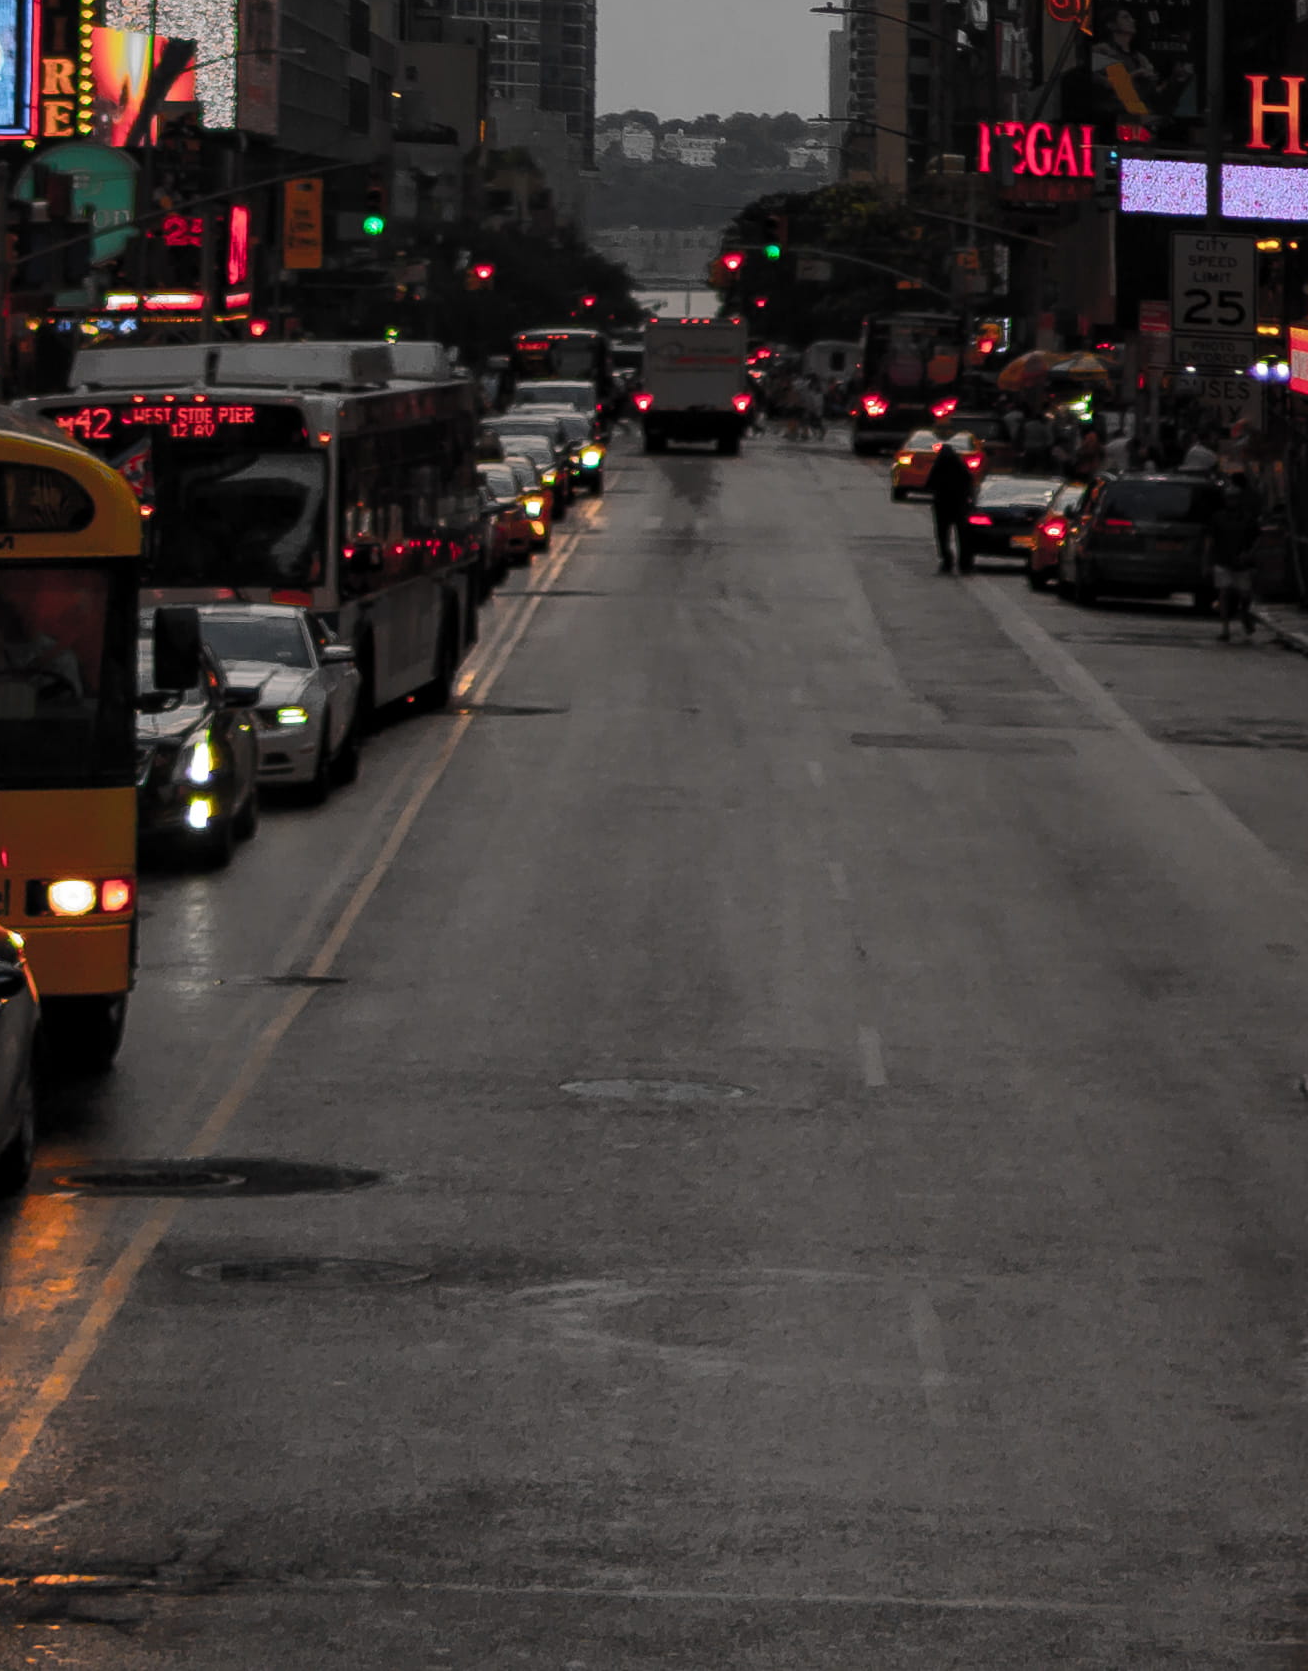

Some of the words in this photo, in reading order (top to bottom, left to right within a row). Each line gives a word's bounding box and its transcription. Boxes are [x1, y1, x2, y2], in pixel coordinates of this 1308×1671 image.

[1195, 239, 1229, 251] CITY
[1188, 256, 1238, 268] SPEED
[1193, 272, 1233, 283] LIMIT
[1184, 288, 1247, 326] 25
[133, 407, 172, 425] WEST
[177, 407, 213, 425] SIDE
[218, 406, 255, 424] PIER
[170, 423, 189, 438] 12
[193, 423, 216, 438] AV
